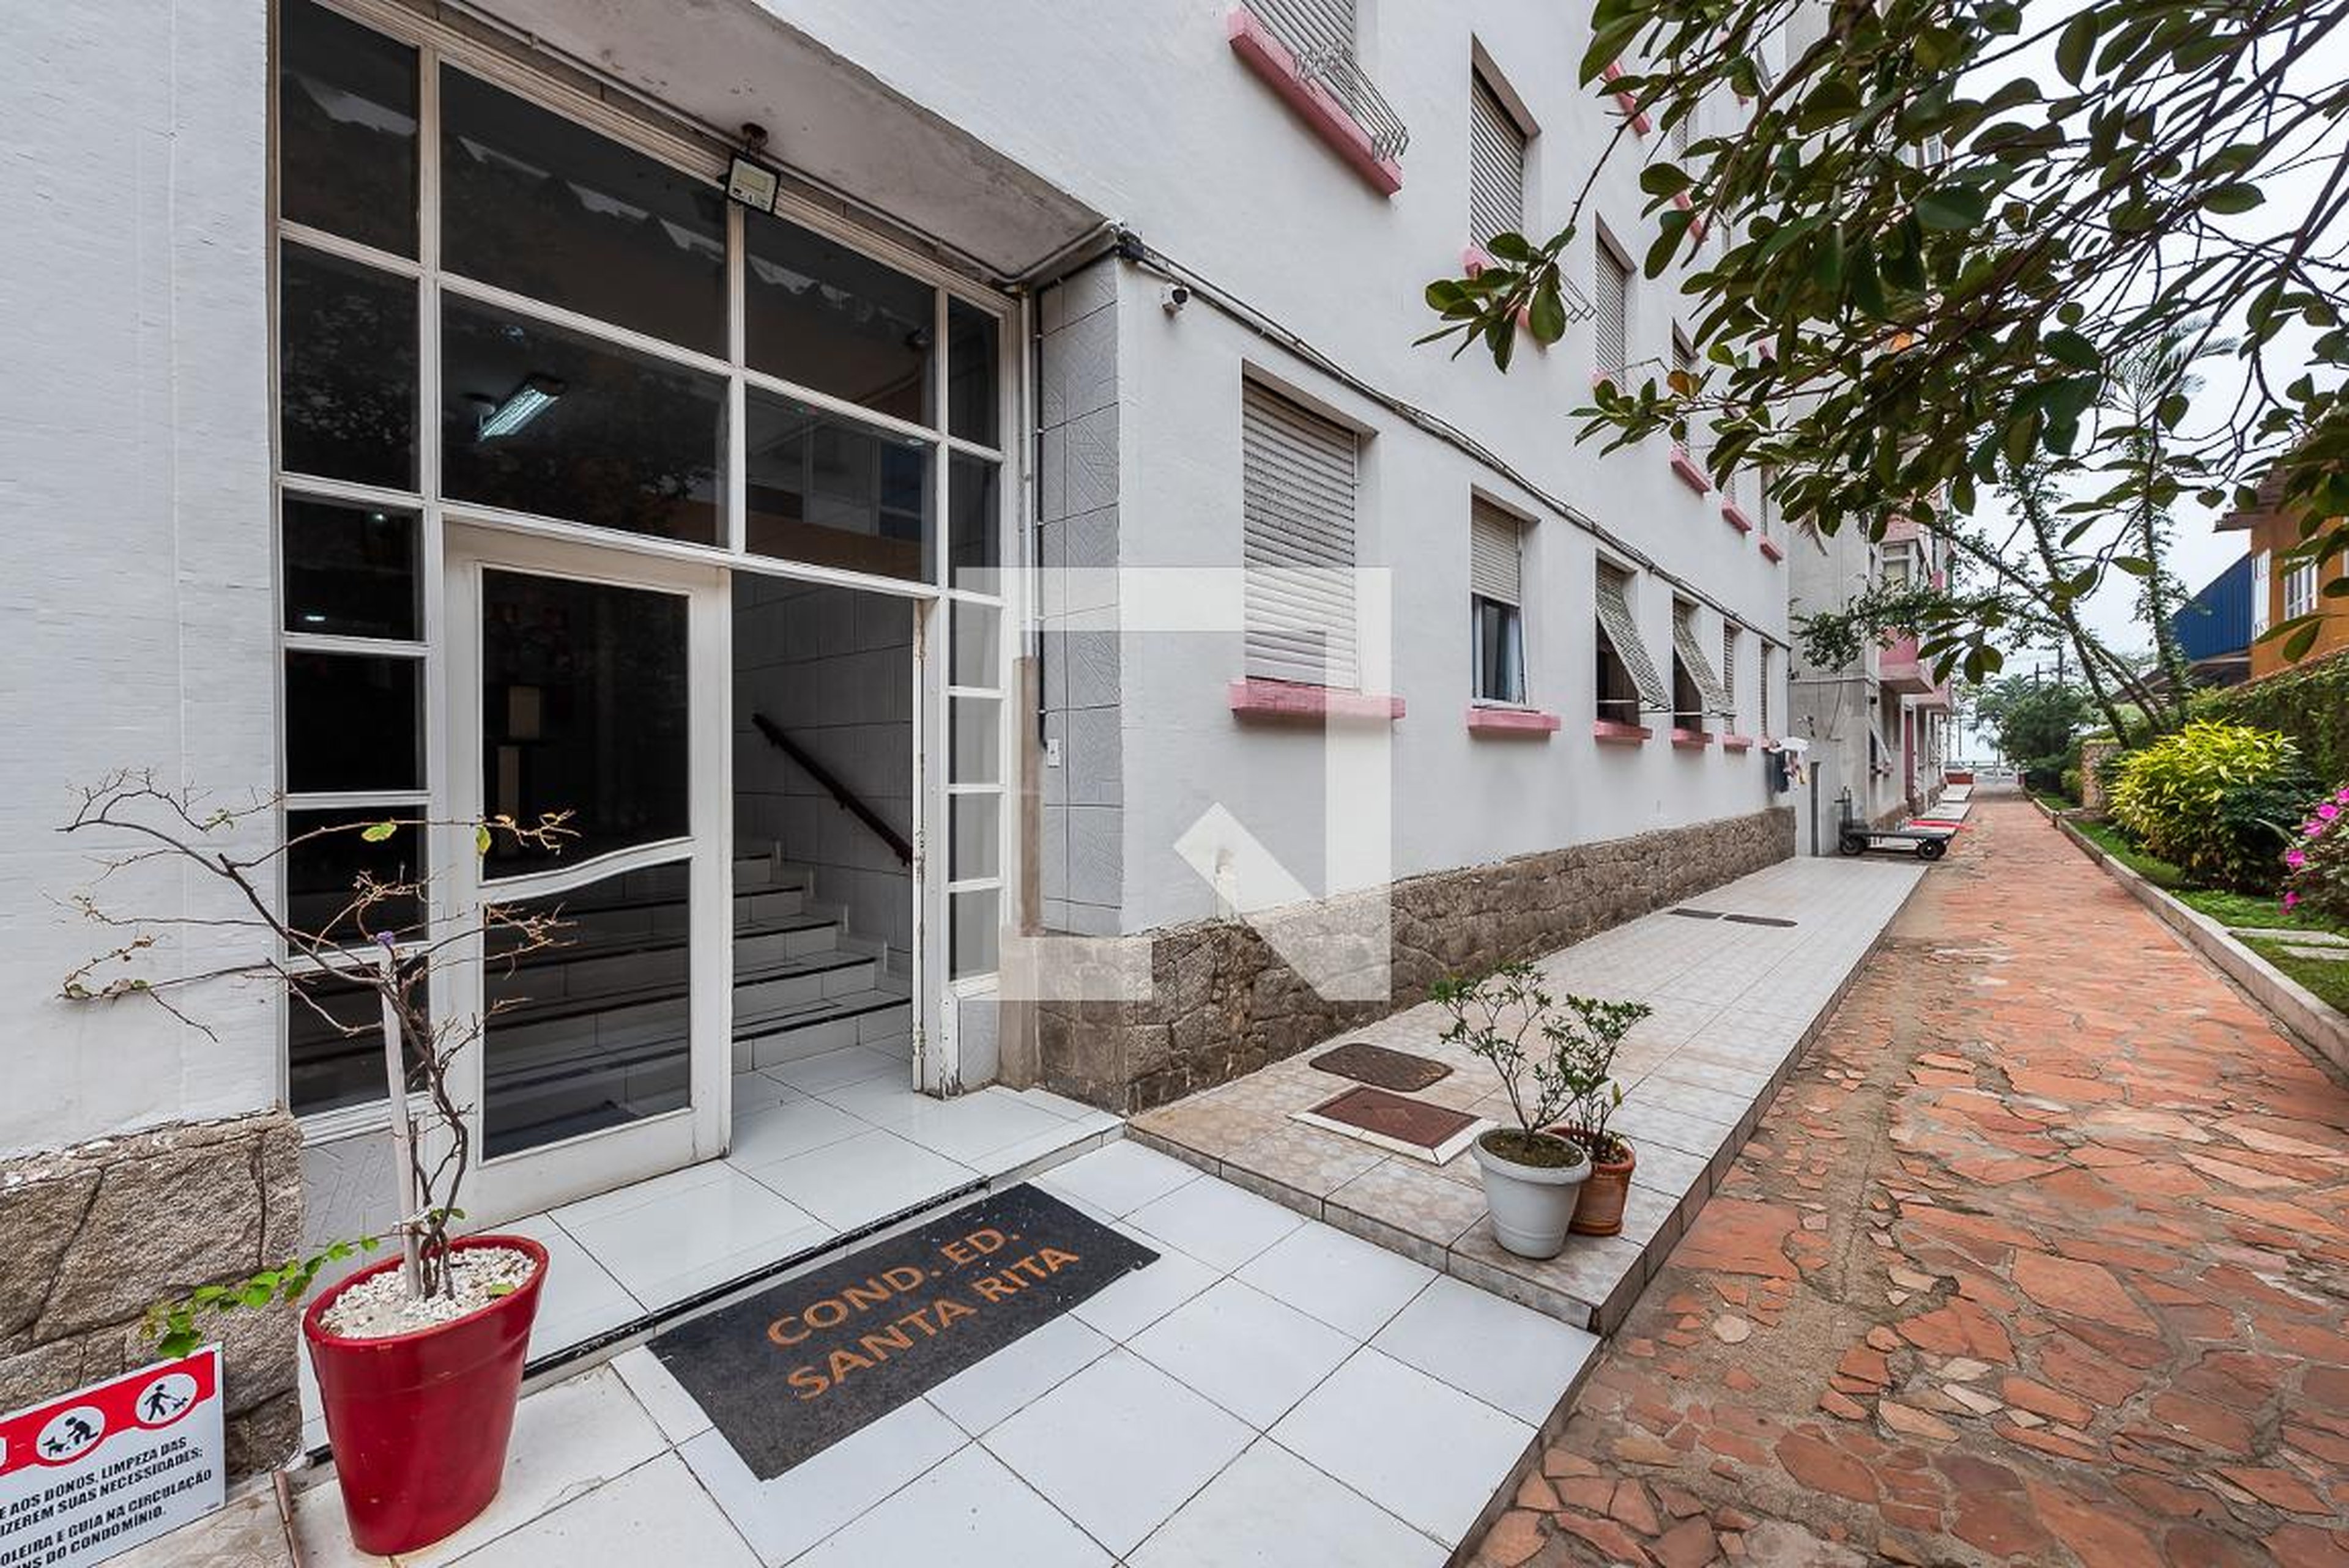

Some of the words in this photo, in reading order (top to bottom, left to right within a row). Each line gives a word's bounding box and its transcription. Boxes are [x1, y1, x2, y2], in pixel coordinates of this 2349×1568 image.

[768, 1267, 942, 1345] COND.
[941, 1229, 1020, 1264] ED.
[787, 1298, 978, 1400] SANTA
[973, 1248, 1080, 1303] RITA
[1, 1535, 53, 1566] OLEIRA
[57, 1530, 65, 1544] E
[69, 1514, 103, 1538] GUIA
[106, 1505, 125, 1523] NA
[128, 1469, 212, 1512] CIRCULAÇÃO
[10, 1494, 40, 1515] AOS
[102, 1449, 158, 1479] LIMPEZA
[161, 1437, 187, 1457] DAS
[58, 1488, 97, 1513] SUAS
[17, 1557, 42, 1568] NS
[46, 1545, 67, 1565] DO
